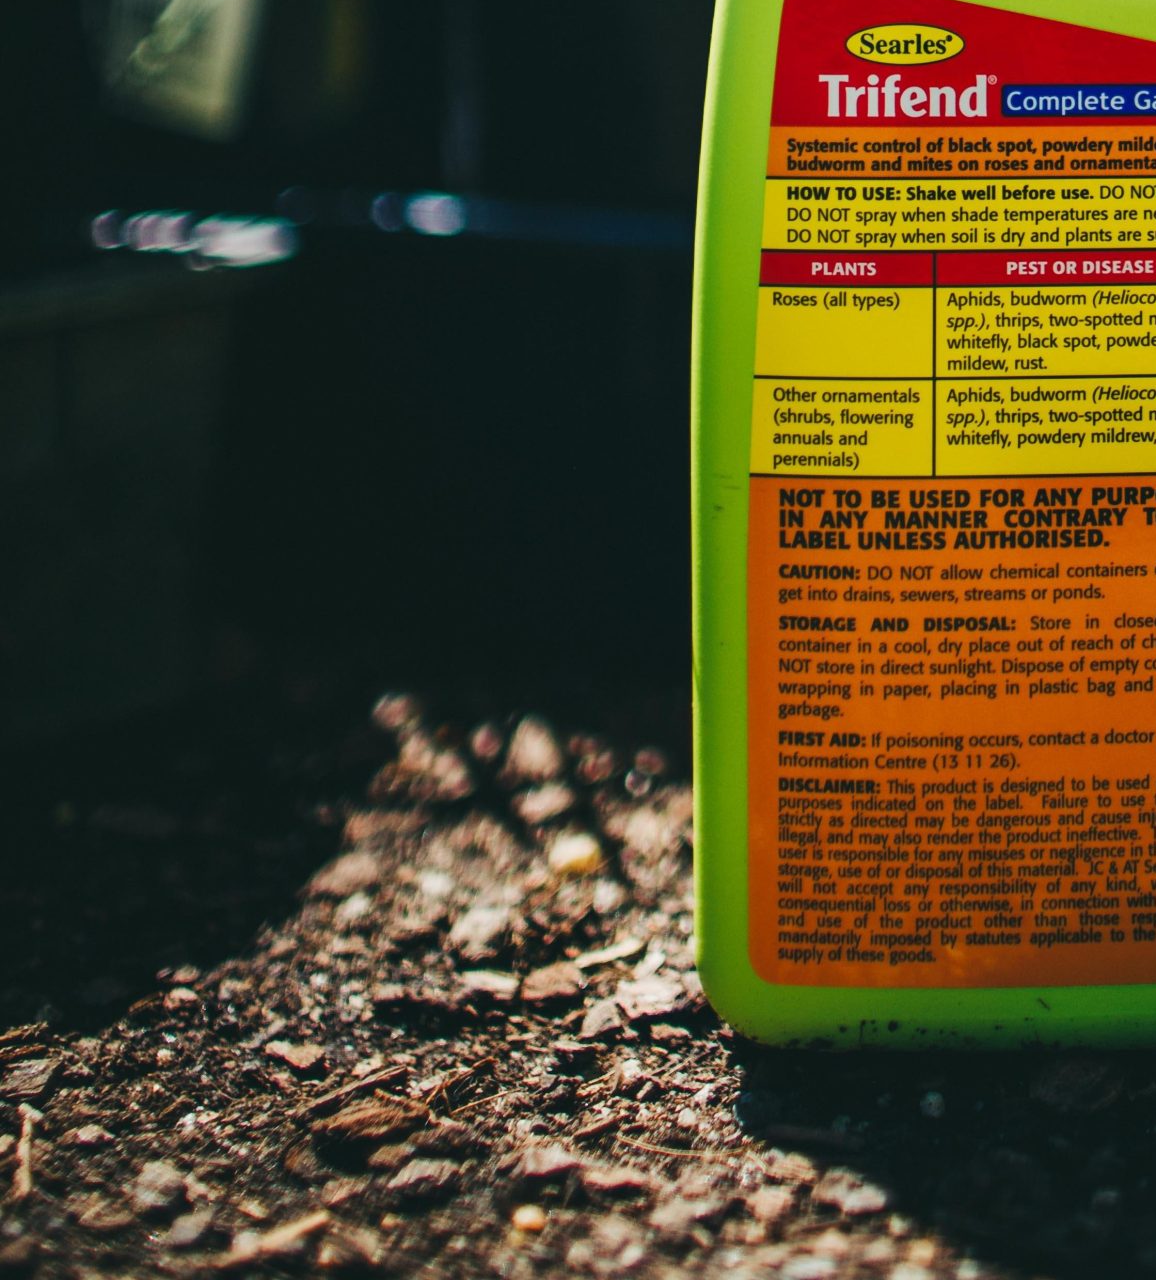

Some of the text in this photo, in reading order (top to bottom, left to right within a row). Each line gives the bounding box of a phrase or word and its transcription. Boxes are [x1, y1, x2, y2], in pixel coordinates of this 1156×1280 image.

[1006, 90, 1125, 115] Complete
[786, 138, 858, 157] Systemic
[862, 137, 922, 153] control
[925, 137, 944, 153] of
[947, 137, 993, 153] black
[996, 138, 1038, 157] spot,
[1041, 136, 1114, 157] powdery
[786, 207, 812, 222] DO
[817, 207, 849, 222] NOT
[855, 210, 897, 227] spray
[901, 205, 946, 222] when
[951, 205, 998, 222] shade
[1002, 206, 1108, 226] temperatures
[1113, 209, 1138, 221] are
[811, 262, 877, 276] PLANTS
[1006, 260, 1154, 275] PEST OR DISEASE
[772, 291, 900, 312] Roses (all types)
[946, 289, 1004, 310] Aphids,
[1010, 288, 1086, 305] budworm
[946, 311, 990, 332] spp.),
[994, 311, 1044, 332] thrips,
[1048, 310, 1143, 332] two-spotted
[773, 408, 913, 429] (shrubs, flowering
[946, 428, 1012, 449] whitefly,
[1016, 427, 1086, 449] powdery
[772, 451, 859, 472] perennials)
[778, 489, 826, 508] NOT
[832, 490, 862, 508] TO
[870, 490, 900, 508] BE
[908, 490, 972, 508] USED
[978, 489, 1025, 508] FOR
[1032, 489, 1082, 508] ANY
[778, 510, 804, 529] IN
[818, 510, 868, 529] ANY
[884, 510, 988, 529] MANNER
[1003, 508, 1128, 528] CONTRARY
[778, 529, 1110, 550] LABEL UNLESS AUTHORISED.
[778, 565, 860, 580] CAUTION:
[866, 565, 894, 580] DO
[899, 565, 933, 580] NOT
[940, 563, 984, 580] allow
[988, 562, 1060, 579] chemical
[1066, 562, 1148, 578] containers
[778, 752, 870, 769] Information
[874, 754, 928, 769] Centre
[966, 754, 982, 769] 11
[888, 778, 916, 794] This
[921, 778, 977, 798] product
[982, 779, 994, 793] is
[1000, 777, 1066, 798] designed
[1070, 778, 1086, 792] to
[1091, 776, 1110, 792] be
[1115, 774, 1150, 791] used
